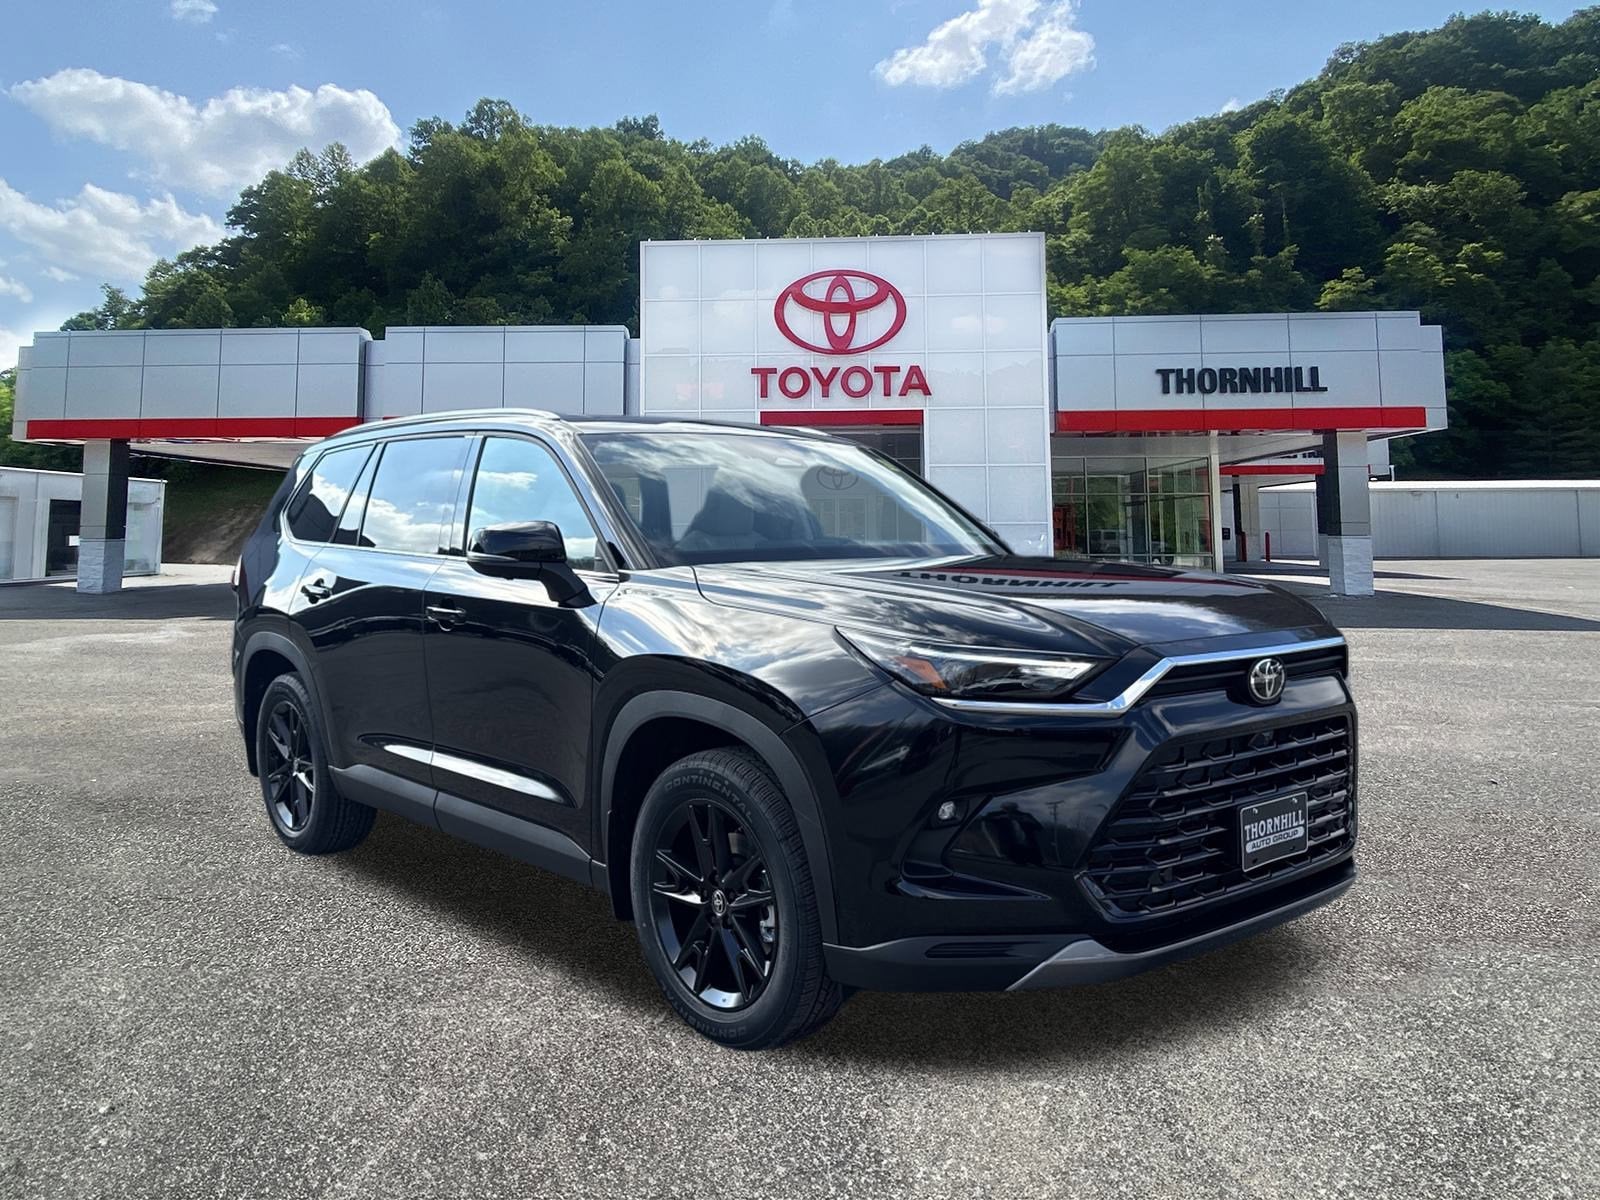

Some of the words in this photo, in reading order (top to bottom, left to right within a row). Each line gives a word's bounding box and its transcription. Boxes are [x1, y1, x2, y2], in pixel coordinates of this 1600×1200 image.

[751, 365, 932, 399] TOYOTA
[1156, 366, 1328, 395] THORNHILL
[1244, 810, 1305, 840] THORNHILL
[1251, 837, 1271, 849] AUTO
[1273, 829, 1299, 842] GROUP
